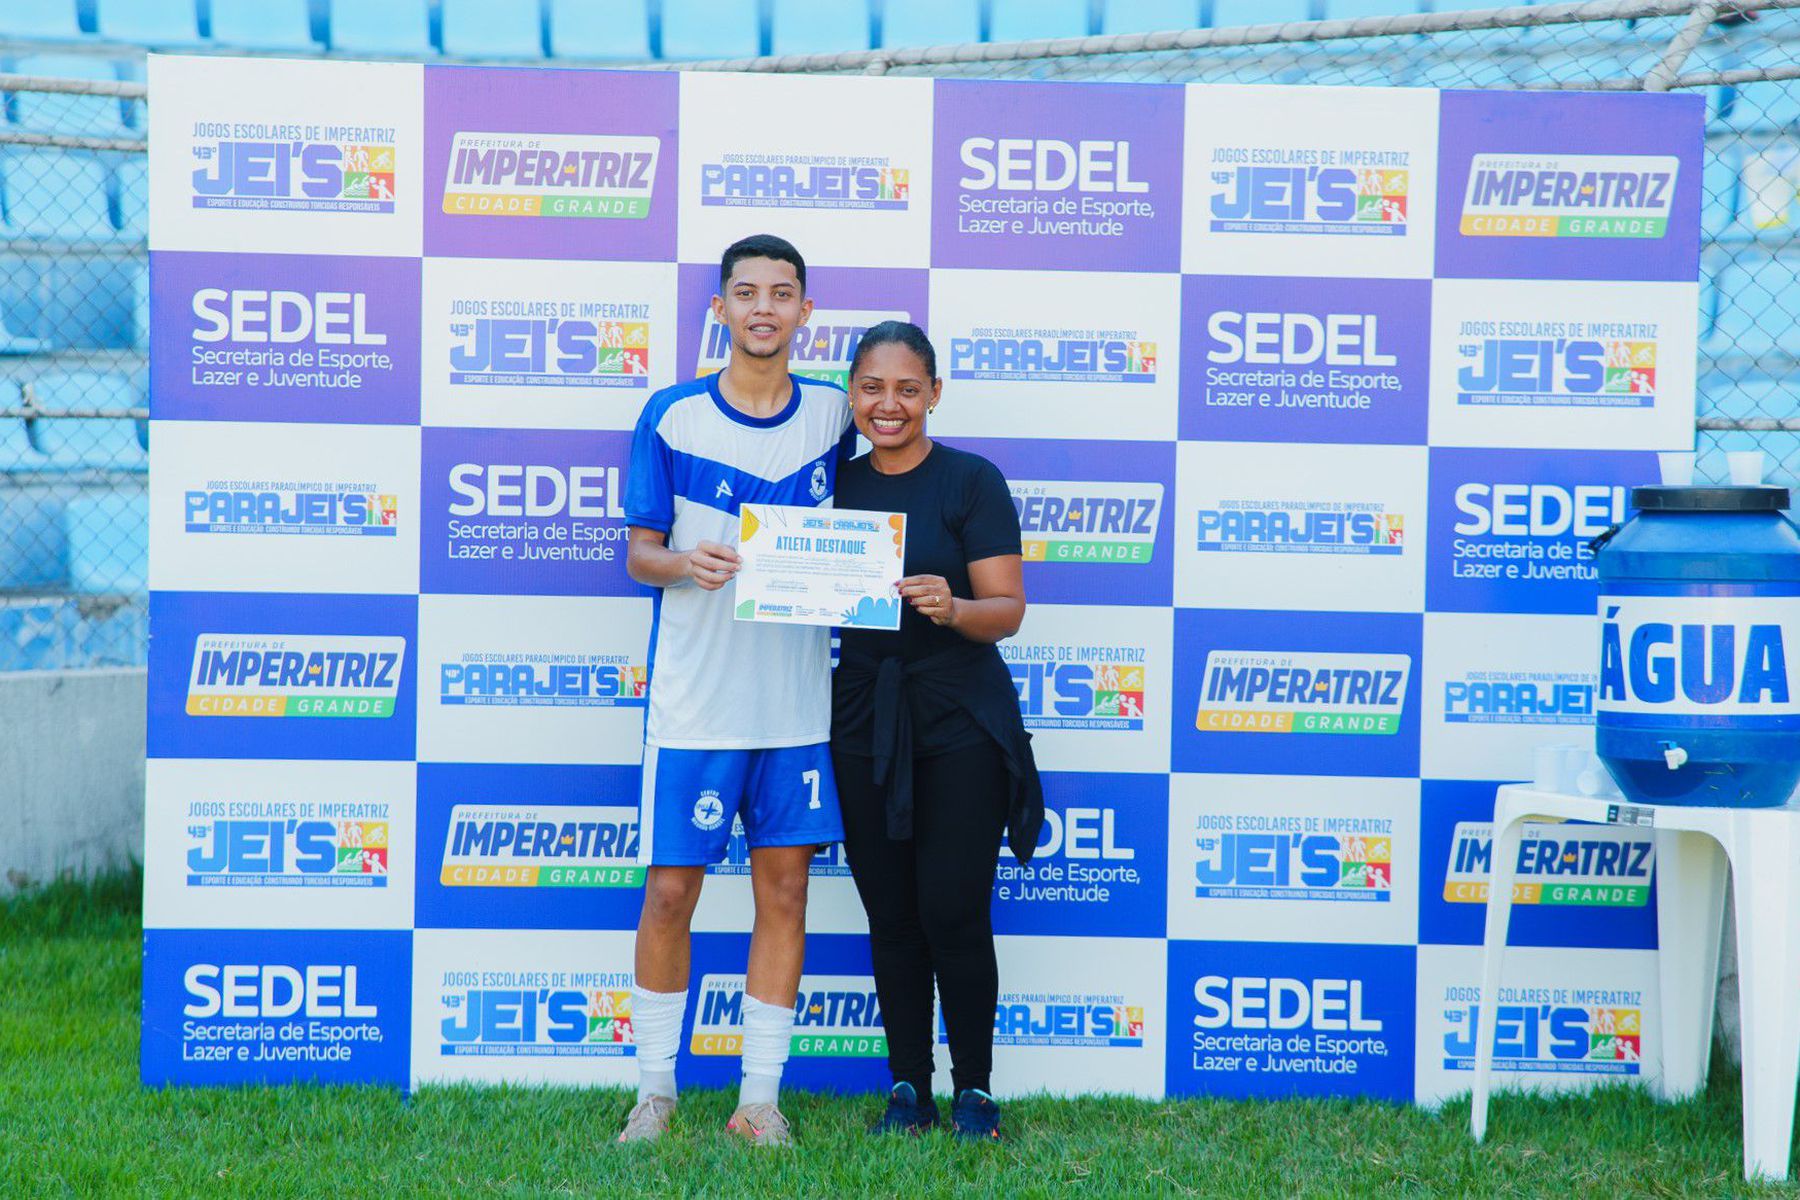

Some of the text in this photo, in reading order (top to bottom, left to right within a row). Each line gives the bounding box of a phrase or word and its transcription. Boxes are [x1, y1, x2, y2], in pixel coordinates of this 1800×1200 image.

[193, 122, 395, 142] JOGOS ESCOLARES DE IMPERATRIZ
[460, 139, 523, 147] PREFEITURA
[192, 140, 342, 197] JEI'S
[454, 149, 652, 188] IMPERATRIZ
[960, 138, 1148, 192] SEDEL
[702, 165, 879, 198] PARAJEI'S
[1210, 166, 1356, 220] JEI'S
[1472, 171, 1670, 208] IMPERATRIZ
[456, 196, 638, 214] CIDADE GRANDE
[959, 194, 1154, 218] Secretaria de Esporte,
[958, 215, 1123, 236] Lazer e Juventude
[1473, 218, 1654, 233] CIDADE GRANDE
[192, 289, 386, 345] SEDEL
[450, 318, 597, 373] JEI'S
[1207, 311, 1396, 366] SEDEL
[192, 346, 393, 370] Secretaria de Esporte,
[951, 339, 1126, 371] PARAJEI'S
[1458, 339, 1604, 392] JEI'S
[192, 367, 362, 388] Lazer e Juventude
[1206, 367, 1402, 391] Secretaria de Esporte,
[1206, 388, 1371, 408] Lazer e Juventude
[230, 482, 269, 490] ESCOLARES
[324, 483, 332, 491] DE
[336, 483, 376, 492] IMPERATRIZ
[448, 464, 626, 518] SEDEL
[186, 492, 366, 524] PARAJEI'S
[448, 520, 630, 542] Secretaria de Esport
[1198, 511, 1374, 543] PARAJEI'S
[448, 541, 614, 561] Lazer e Juventude
[776, 536, 866, 554] ATLETA DESTAQUE
[1058, 545, 1141, 558] GRANDE
[1454, 539, 1543, 558] Secretaria
[1548, 542, 1572, 559] de
[1453, 560, 1598, 580] Lazer e Juventu
[1600, 606, 1790, 704] ÁGUA
[197, 651, 398, 688] IMPERATRIZ
[441, 664, 619, 696] PARAJEI'S
[1008, 662, 1094, 716] EI'S
[1208, 667, 1402, 705] IMPERATRIZ
[200, 698, 383, 713] CIDADE GRANDE
[1210, 713, 1388, 730] CIDADE GRANDE
[802, 768, 822, 810] 7
[188, 802, 388, 817] JOGOS ESCOLARES DE IMPERATRIZ
[1196, 815, 1391, 832] JOGOS ESCOLARES DE IMPERATRIZ
[187, 820, 336, 872] JEI'S
[1455, 839, 1651, 876] IMERATRIZ
[1196, 832, 1340, 886] JEI'S
[454, 868, 634, 883] CIDADE GRANDE
[1040, 864, 1063, 880] de
[1069, 864, 1140, 884] Esporte,
[999, 883, 1110, 902] e Juventude
[1553, 888, 1636, 901] GRANDE
[184, 965, 377, 1017] SEDEL
[1194, 976, 1382, 1031] SEDEL
[441, 990, 587, 1042] JEI'S
[183, 1022, 383, 1042] Secretaria de Esporte,
[1193, 1032, 1388, 1056] Secretaria de Esporte,
[183, 1043, 352, 1060] Lazer e Juventude
[704, 1038, 882, 1052] CID GRANDE
[1193, 1052, 1357, 1073] Lazer e Juventude
